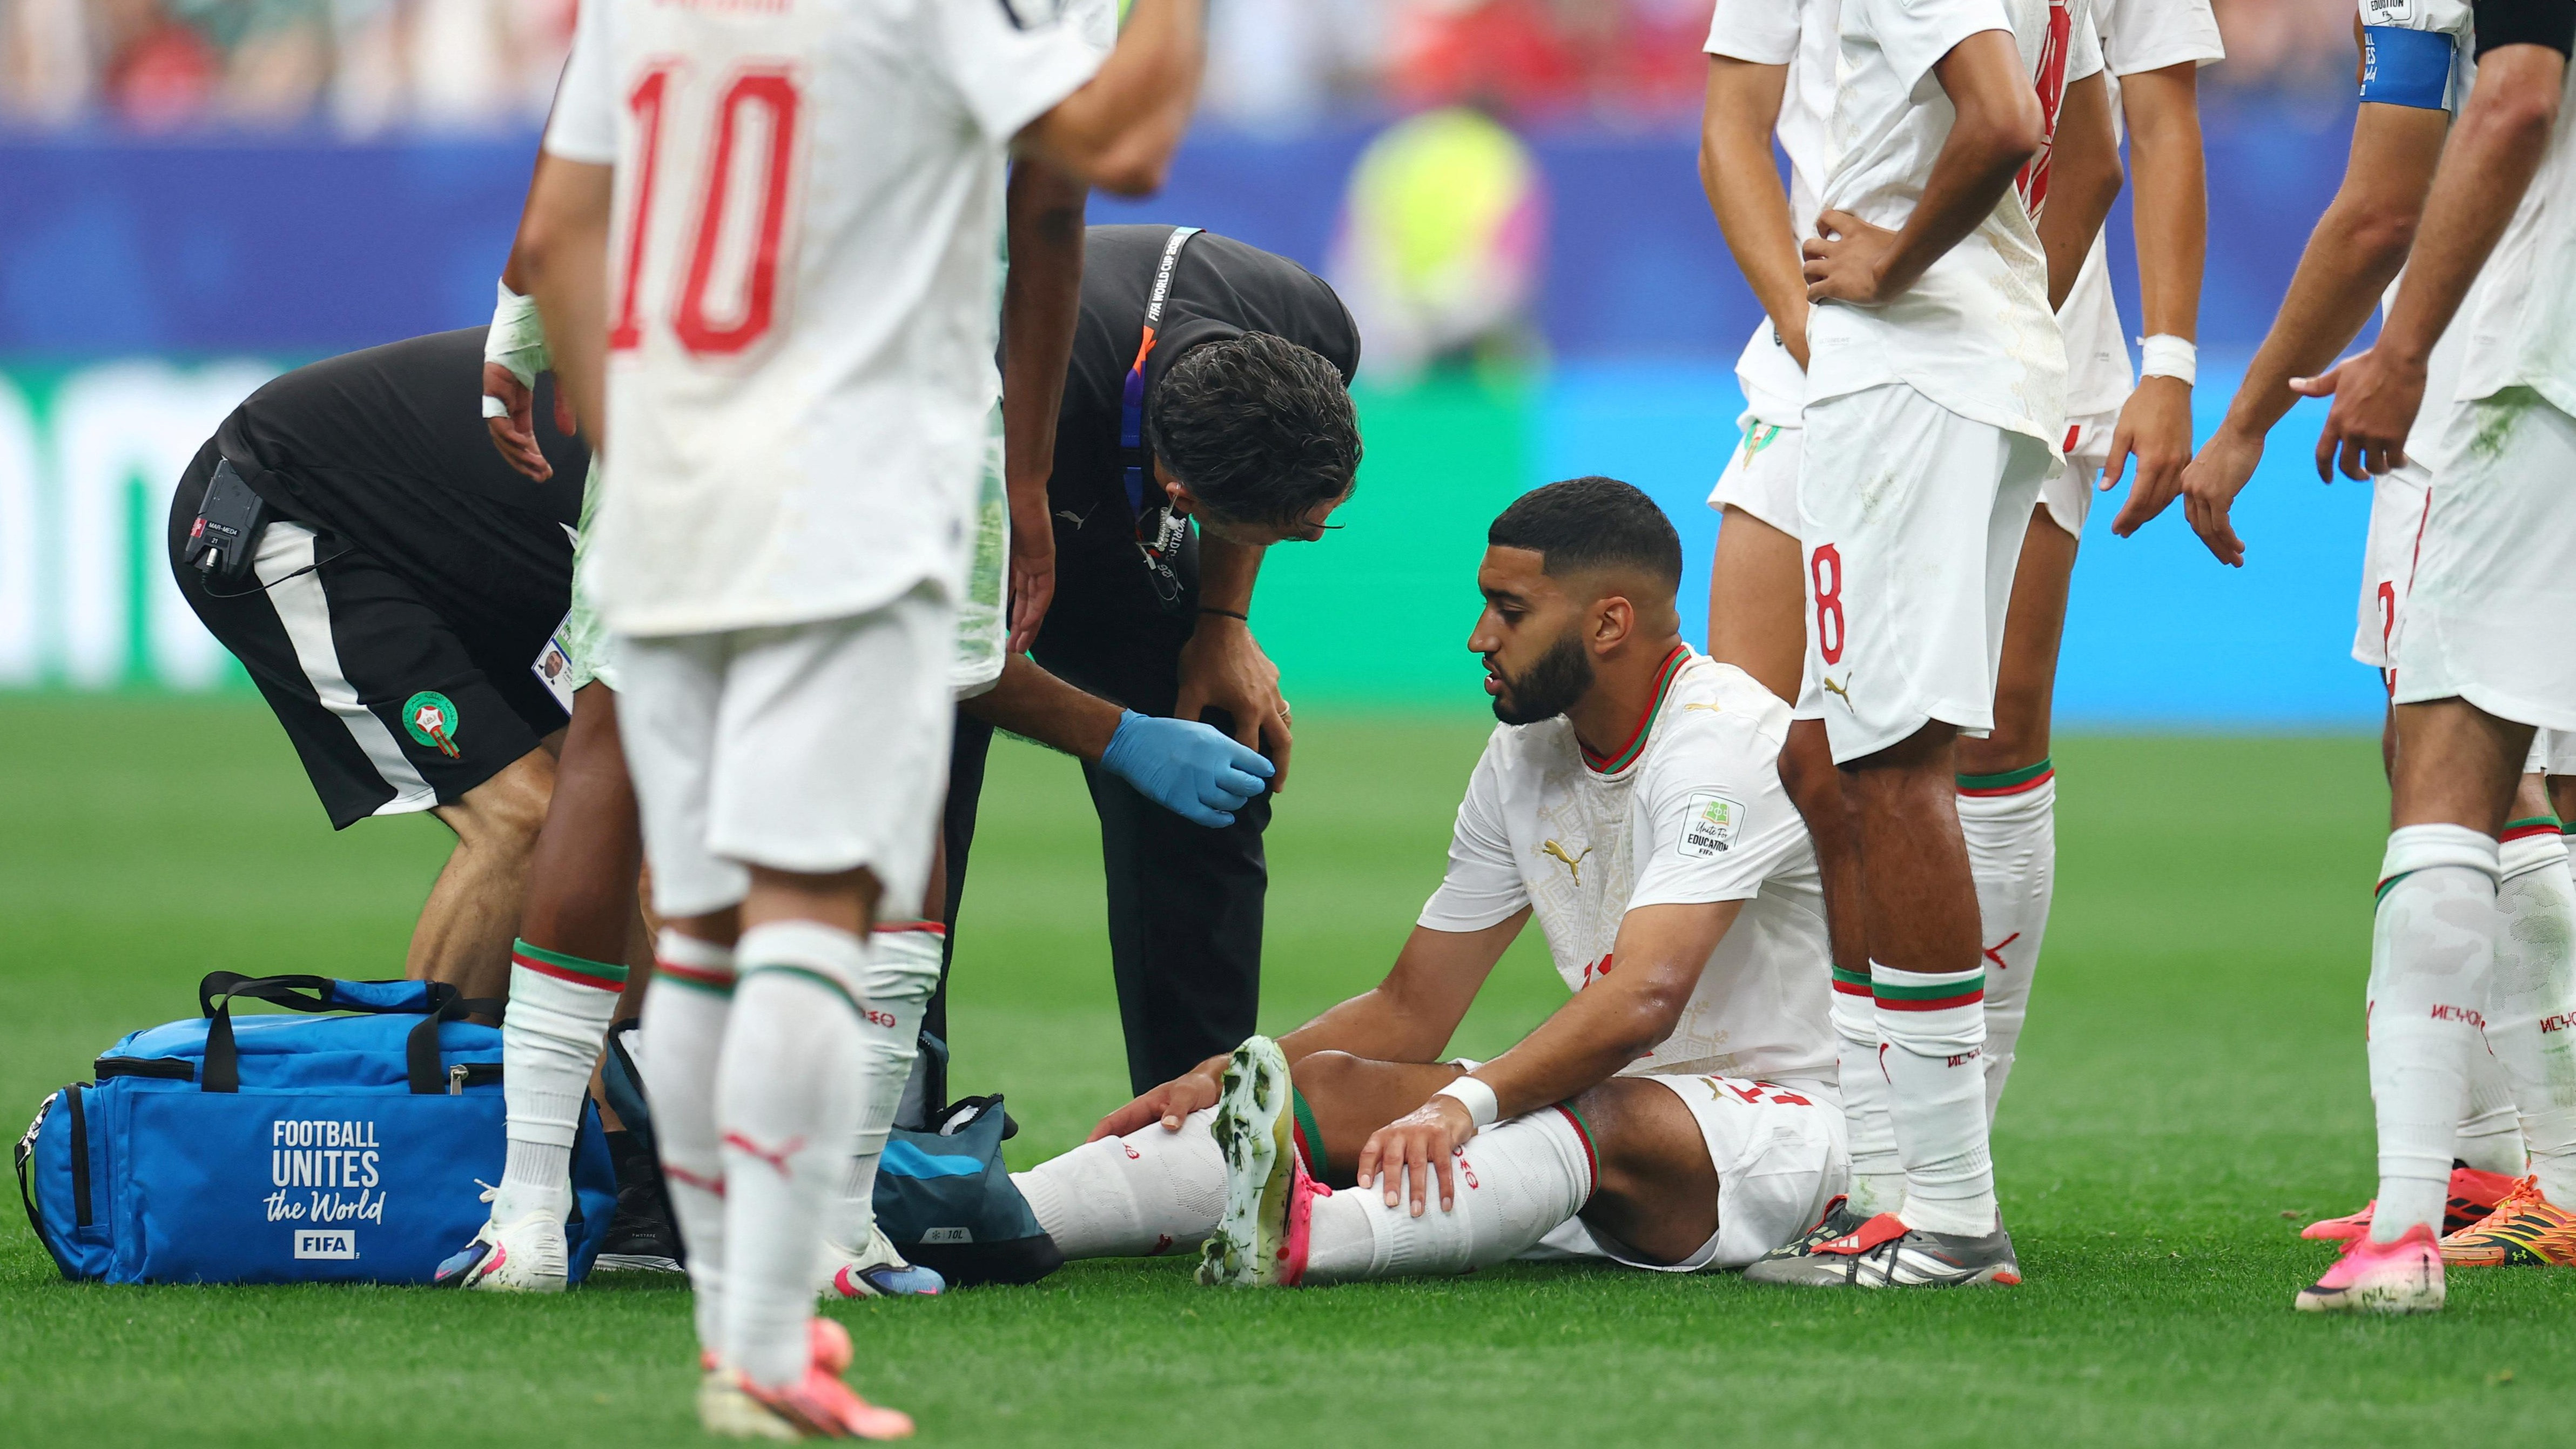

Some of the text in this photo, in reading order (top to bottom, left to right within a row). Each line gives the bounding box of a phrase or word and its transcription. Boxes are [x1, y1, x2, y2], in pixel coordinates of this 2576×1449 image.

[608, 64, 802, 355] 10
[1161, 255, 1174, 271] CUP
[1152, 271, 1169, 301] WORLD
[1148, 303, 1162, 322] FIFA
[208, 522, 238, 535] MAR-MED4
[1811, 542, 1844, 666] 8
[1696, 821, 1727, 838] Unite For
[1687, 834, 1728, 852] EDUCATION
[273, 1120, 380, 1148] FOOTBALL
[272, 1150, 380, 1188] UNITES
[263, 1189, 387, 1225] the World
[948, 1230, 963, 1239] 10L
[303, 1237, 347, 1252] FIFA
